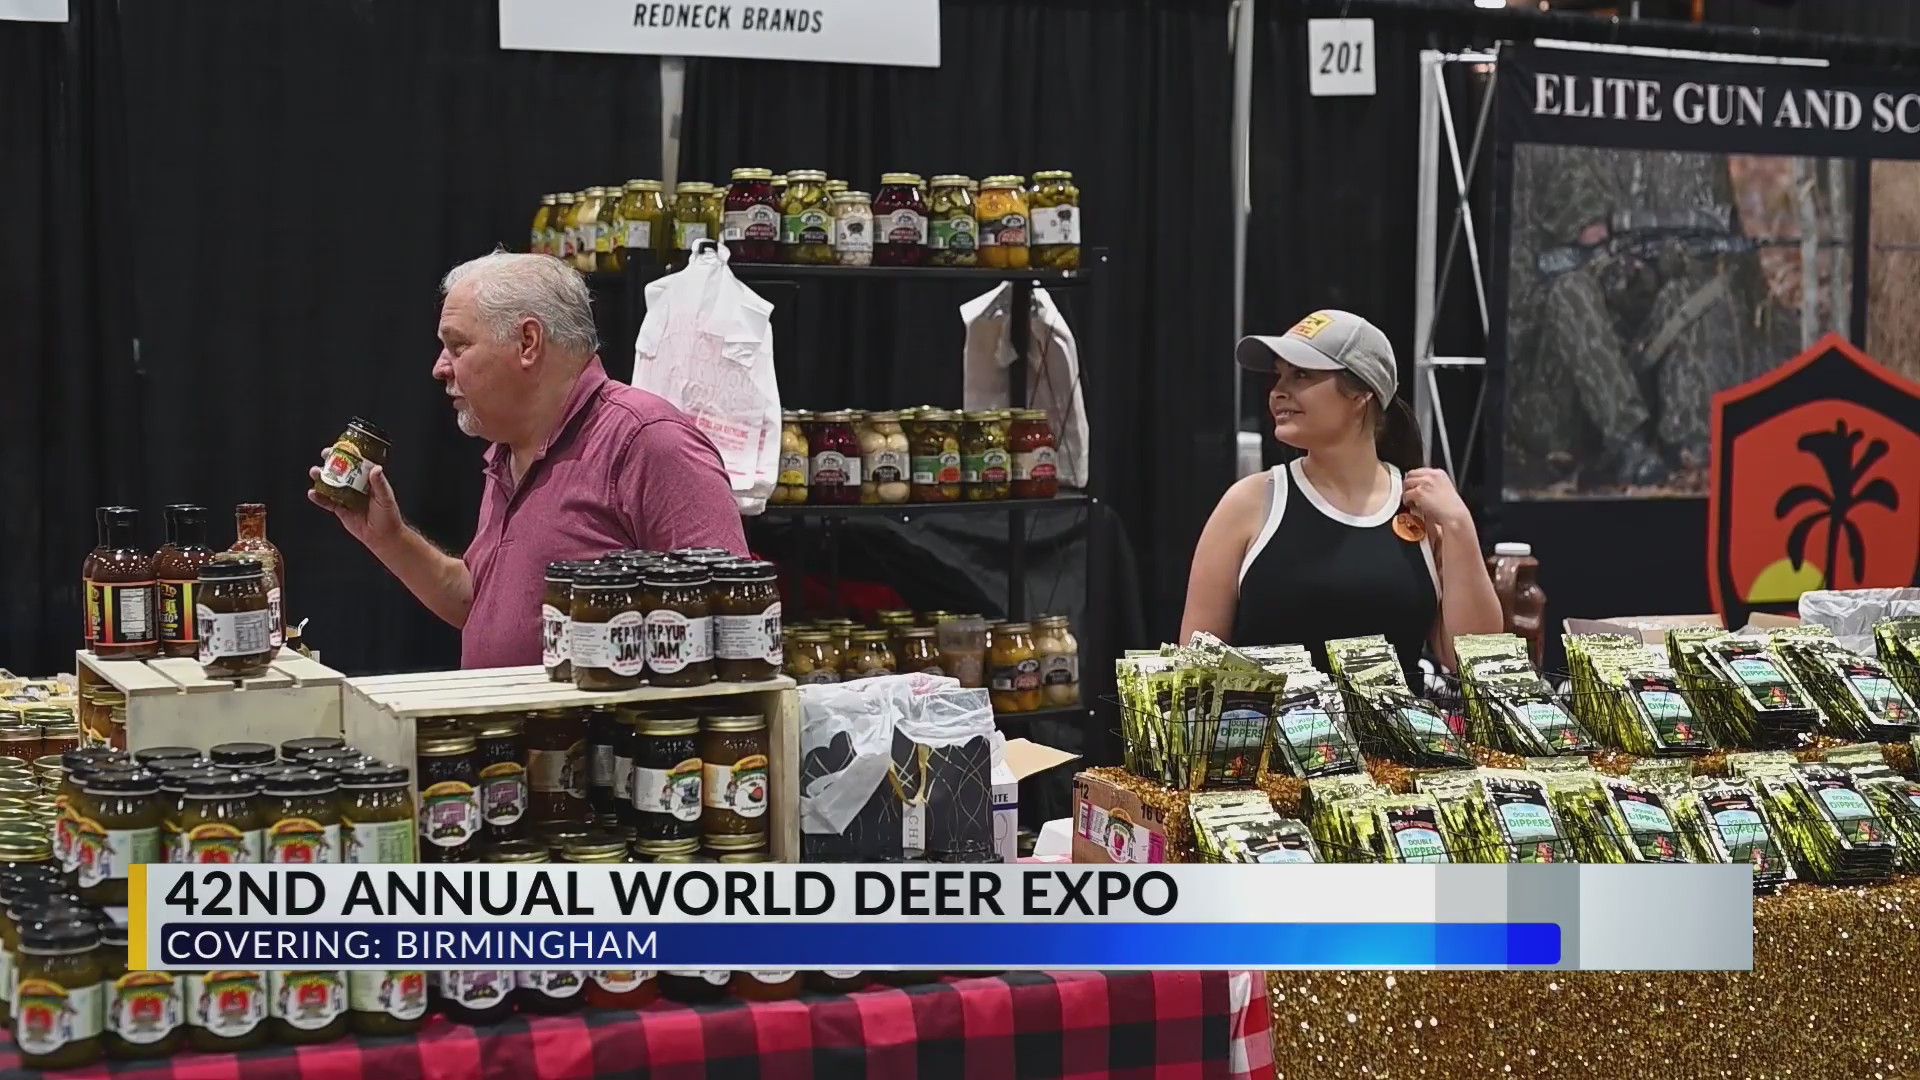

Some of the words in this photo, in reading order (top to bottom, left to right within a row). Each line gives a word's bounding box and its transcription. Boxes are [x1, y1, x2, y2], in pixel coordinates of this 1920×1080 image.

[634, 3, 731, 29] REDNECK
[741, 7, 824, 34] BRANDS
[1319, 41, 1364, 75] 201
[1534, 73, 1662, 121] ELITE
[1673, 81, 1764, 127] GUN
[1773, 88, 1862, 132] AND
[650, 642, 680, 659] JAM
[1220, 727, 1264, 738] DIPPERS
[1286, 719, 1330, 735] DIPPERS
[1079, 781, 1090, 800] 12
[1141, 804, 1153, 821] 16
[1628, 813, 1669, 826] DIPPERS
[1508, 818, 1551, 828] DIPPERS
[1723, 826, 1764, 836] DIPPERS
[1404, 846, 1442, 858] DIPPERS
